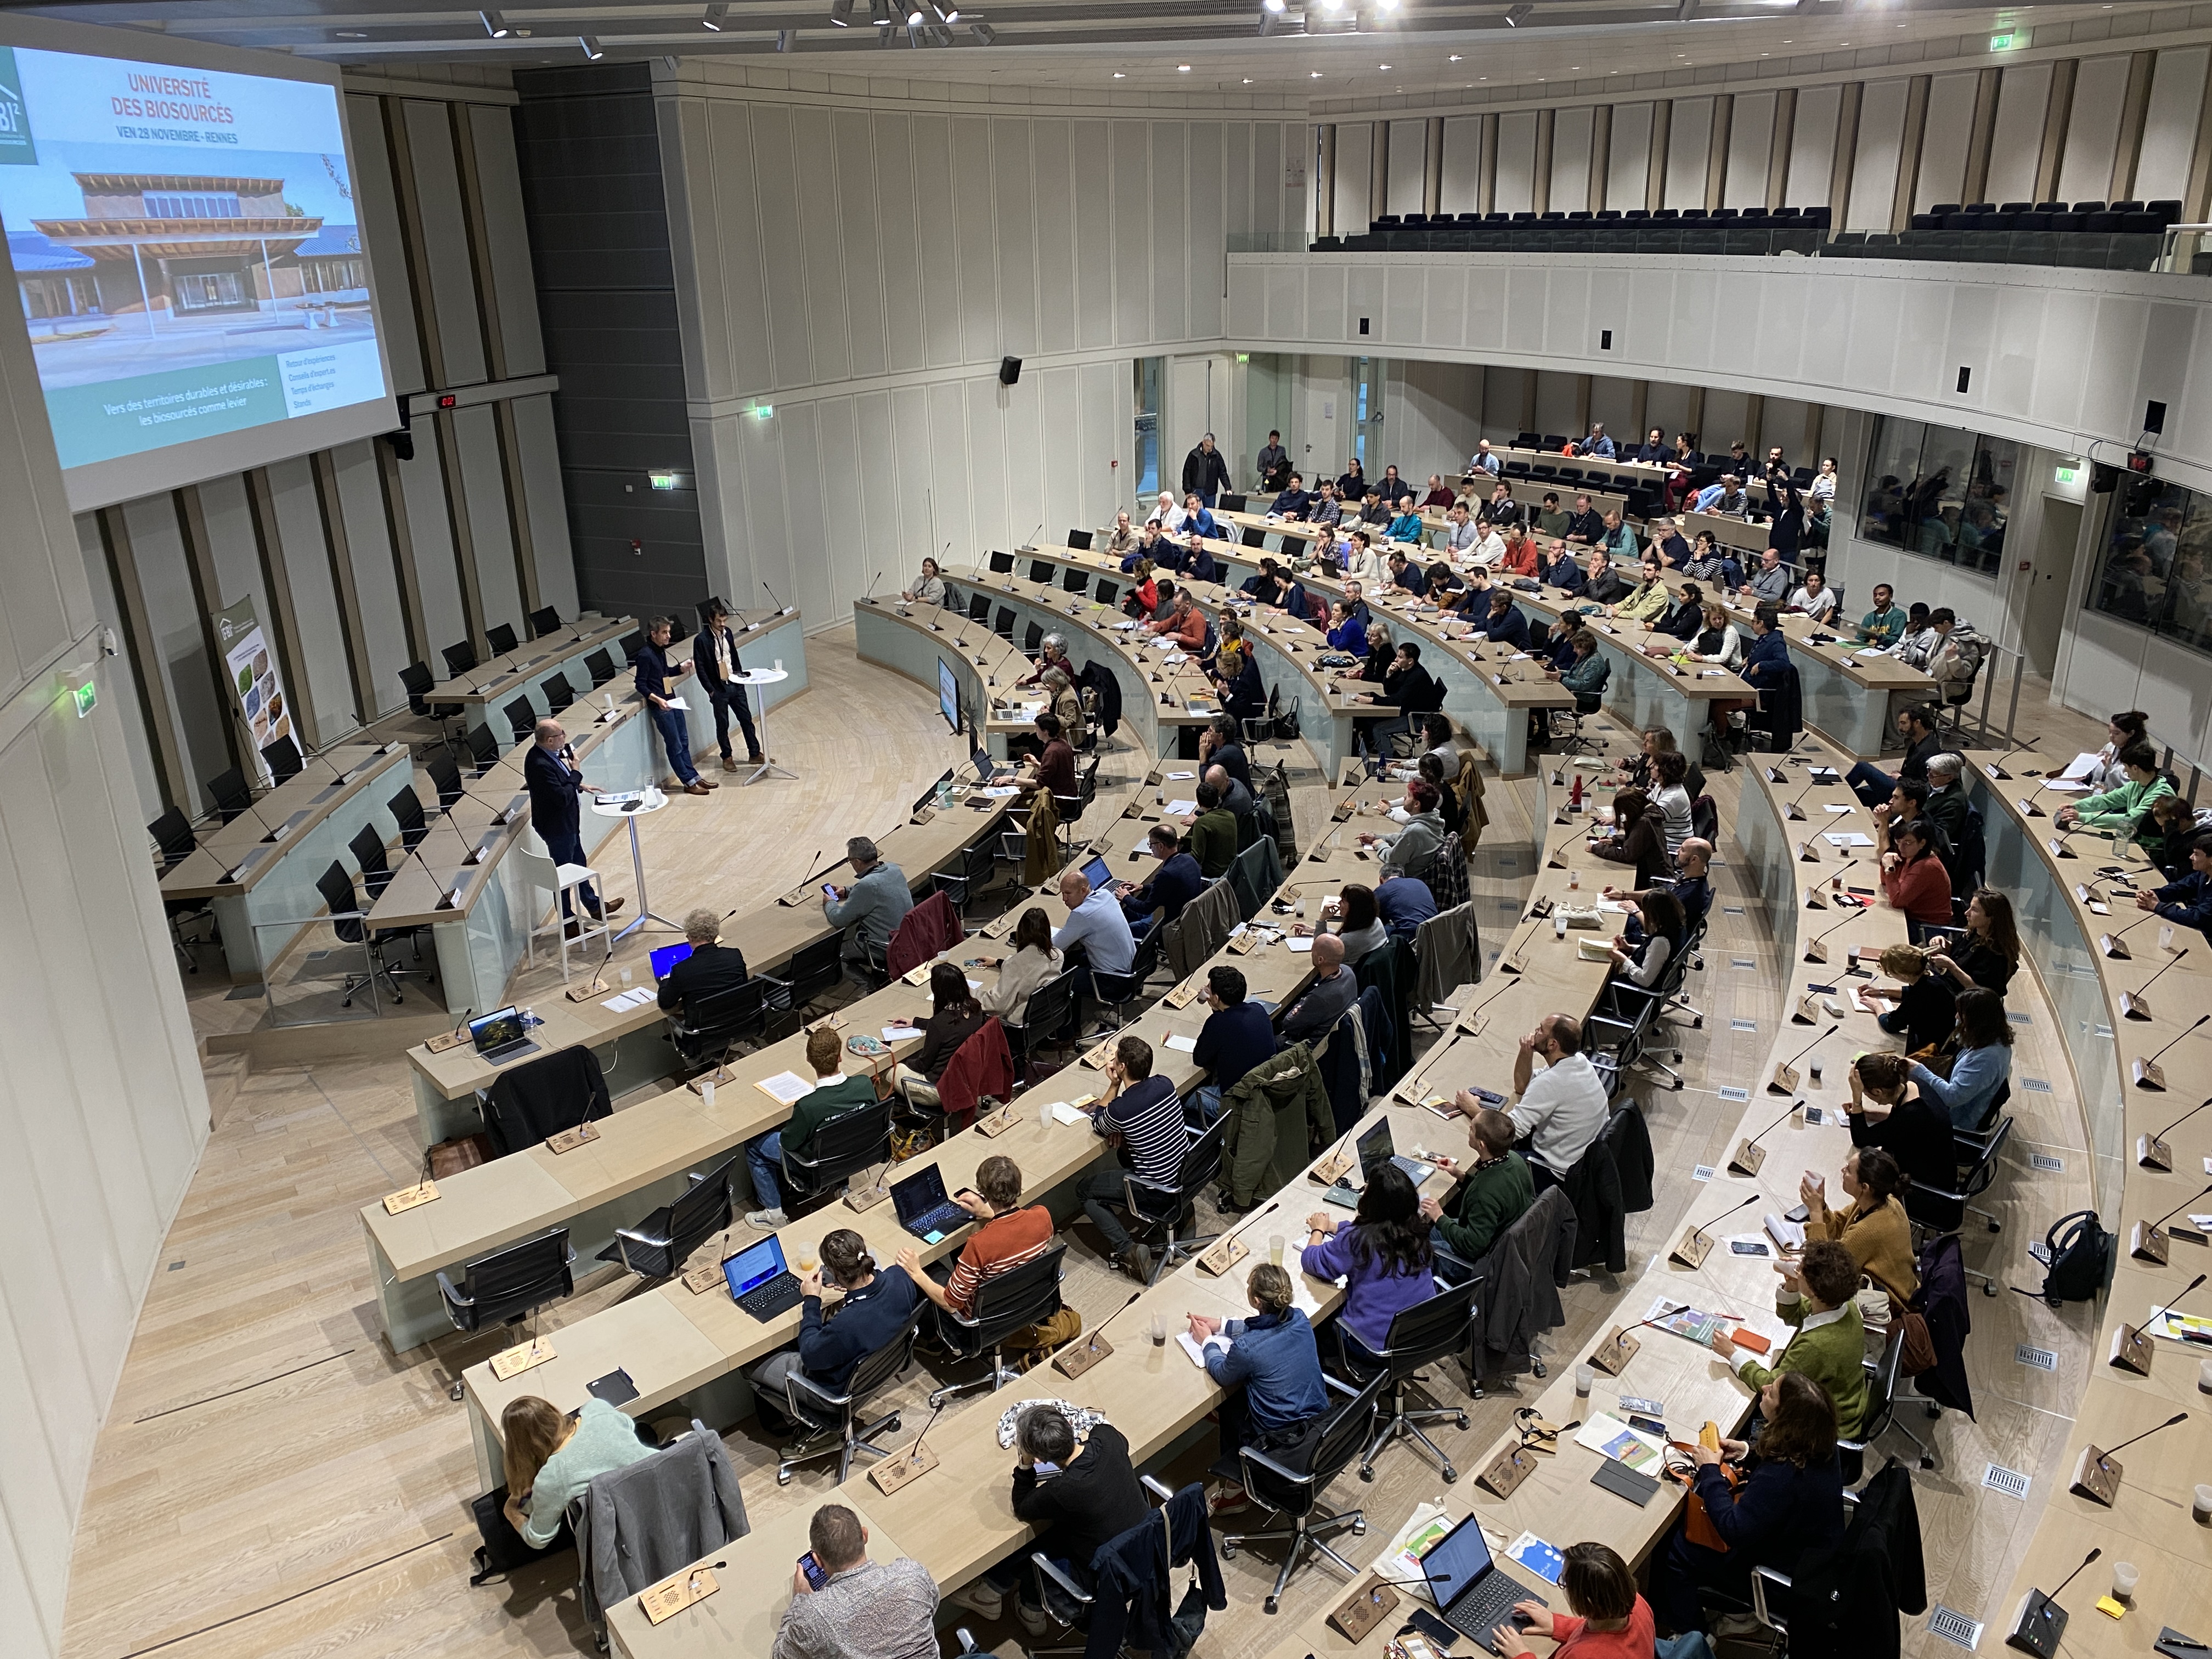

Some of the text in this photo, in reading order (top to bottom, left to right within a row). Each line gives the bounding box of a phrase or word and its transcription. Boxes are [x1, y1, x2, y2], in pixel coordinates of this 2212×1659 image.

[128, 73, 211, 99] UNIVERSITÉ
[111, 97, 234, 123] DES BIOSOURCÉS
[116, 126, 137, 138] VEN
[137, 127, 150, 139] 28
[150, 128, 201, 142] NOVEMBRE
[204, 132, 238, 144] RENNES
[103, 404, 126, 415] Vers
[126, 400, 143, 411] des
[143, 393, 185, 409] territoires
[185, 386, 218, 402] durables
[219, 386, 228, 394] et
[228, 378, 264, 392] désirables
[139, 397, 247, 426] les biosourcés comme levier
